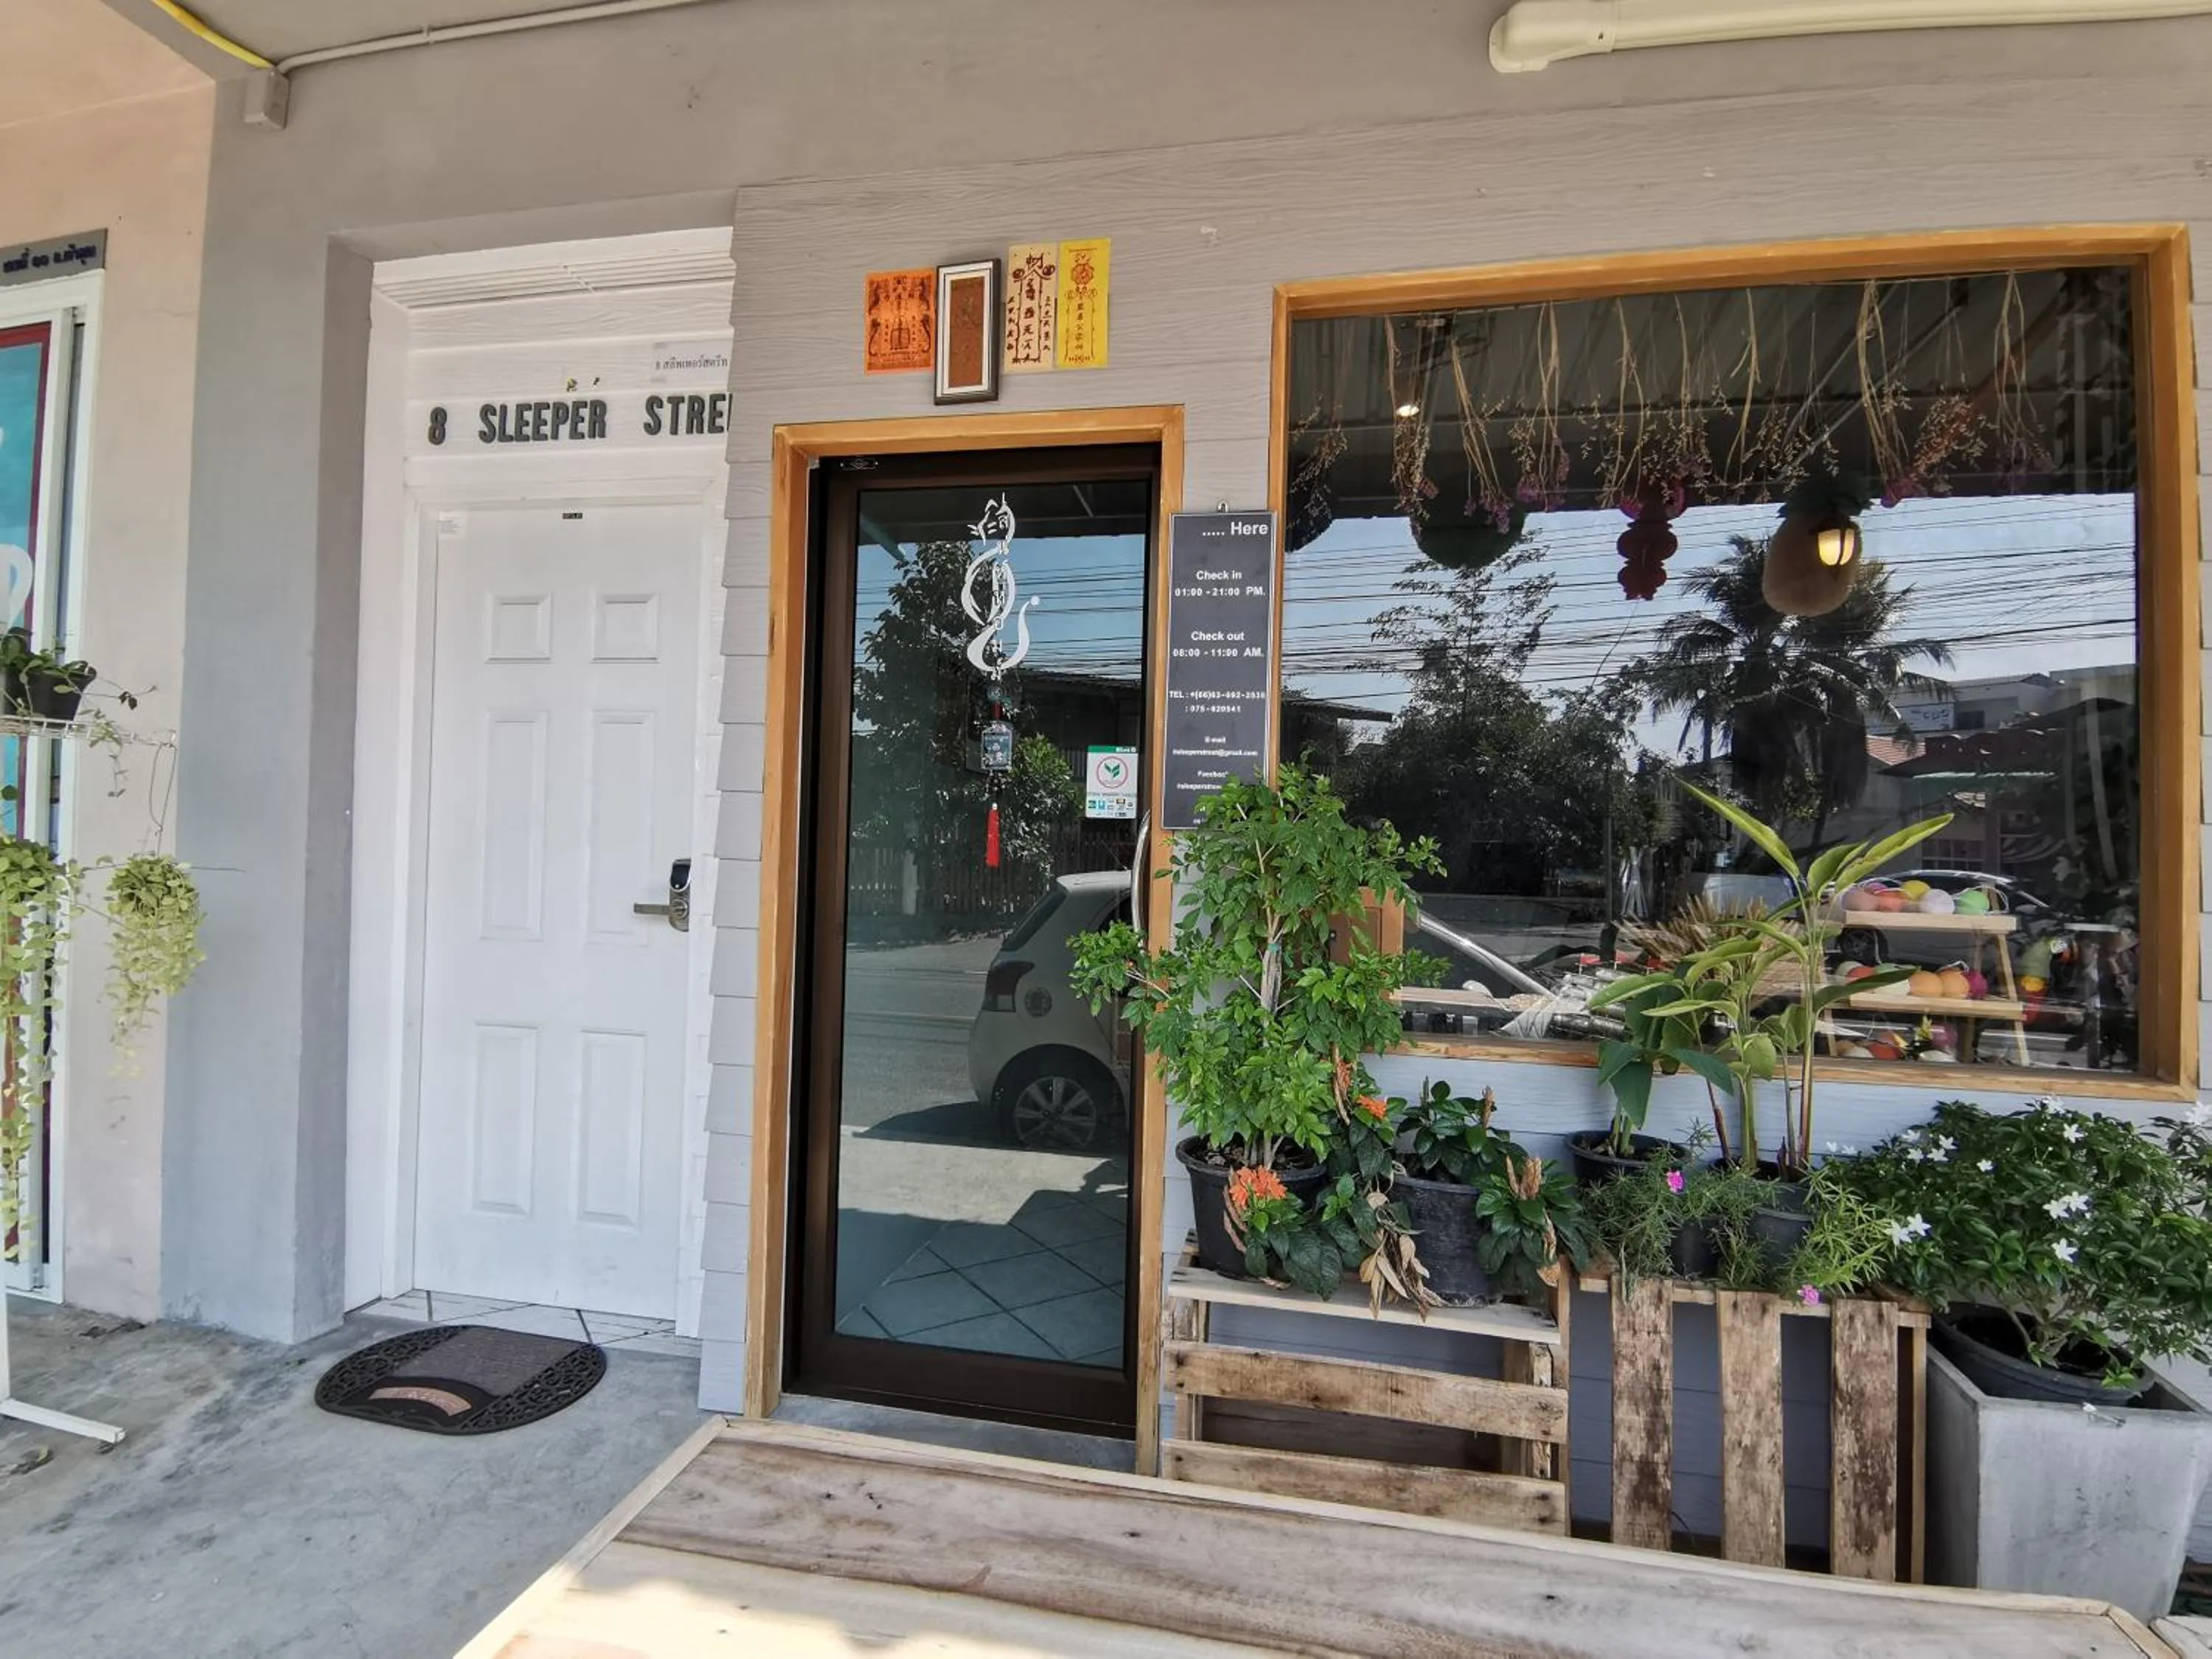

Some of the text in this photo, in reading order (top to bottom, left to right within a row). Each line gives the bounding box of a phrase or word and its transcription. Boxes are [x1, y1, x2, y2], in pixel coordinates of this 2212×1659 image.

[428, 393, 732, 445] 8 SLEEPER STRE
[1231, 521, 1268, 535] Here
[1196, 570, 1242, 580] Check in
[1175, 588, 1203, 597] 01:00
[1246, 586, 1266, 596] PM.
[1191, 631, 1245, 641] Check out
[1211, 648, 1238, 657] 11:00
[1243, 647, 1265, 657] AM.
